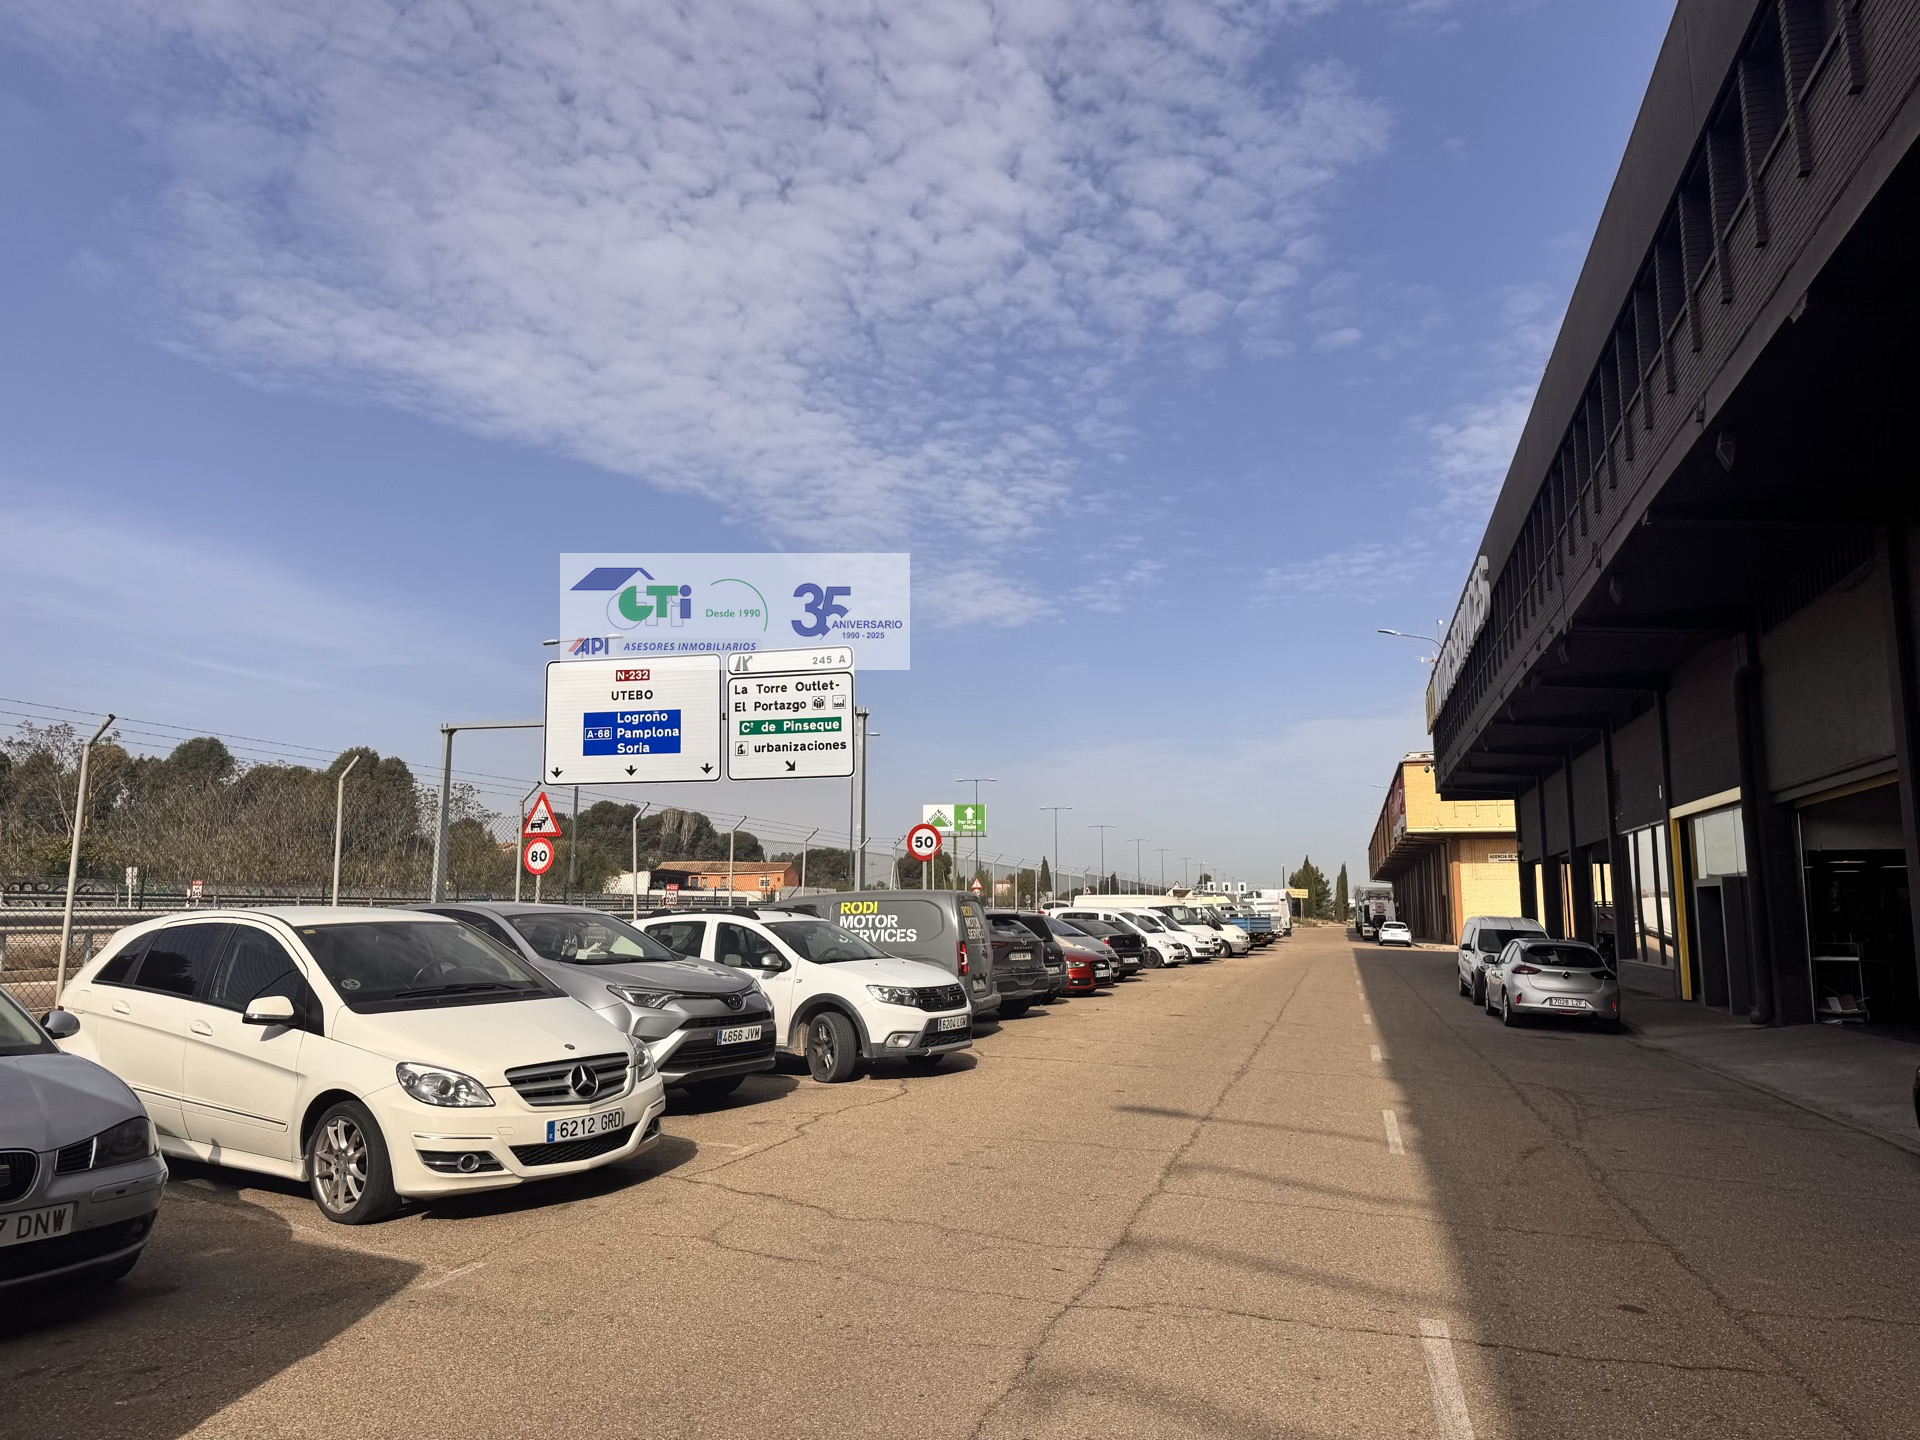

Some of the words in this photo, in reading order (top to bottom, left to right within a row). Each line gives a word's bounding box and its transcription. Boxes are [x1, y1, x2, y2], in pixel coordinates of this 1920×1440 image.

[812, 655, 833, 665] 245
[838, 654, 846, 664] A
[616, 670, 649, 681] N-232
[734, 684, 748, 695] La
[756, 683, 788, 694] Torre
[795, 680, 840, 692] Outlet-
[611, 689, 654, 701] UTEBO
[734, 701, 746, 712] El
[754, 700, 807, 712] Portazgo
[617, 711, 668, 725] Logroño
[761, 721, 776, 732] de
[783, 720, 840, 732] Pinseque
[586, 729, 611, 739] A-68
[616, 726, 680, 739] Pamplona
[616, 742, 650, 754] Soria
[754, 741, 847, 753] urbanizaciones
[914, 836, 934, 848] 50
[530, 850, 548, 863] 80
[840, 901, 878, 914] RODI
[839, 915, 898, 928] MOTOR
[965, 917, 981, 928] MOTOR
[942, 1018, 956, 1030] 6204
[722, 1029, 743, 1042] 4656
[744, 1027, 760, 1040] JVM
[560, 1117, 596, 1138] 6212
[600, 1111, 621, 1131] GRD
[16, 1208, 67, 1239] DNW
